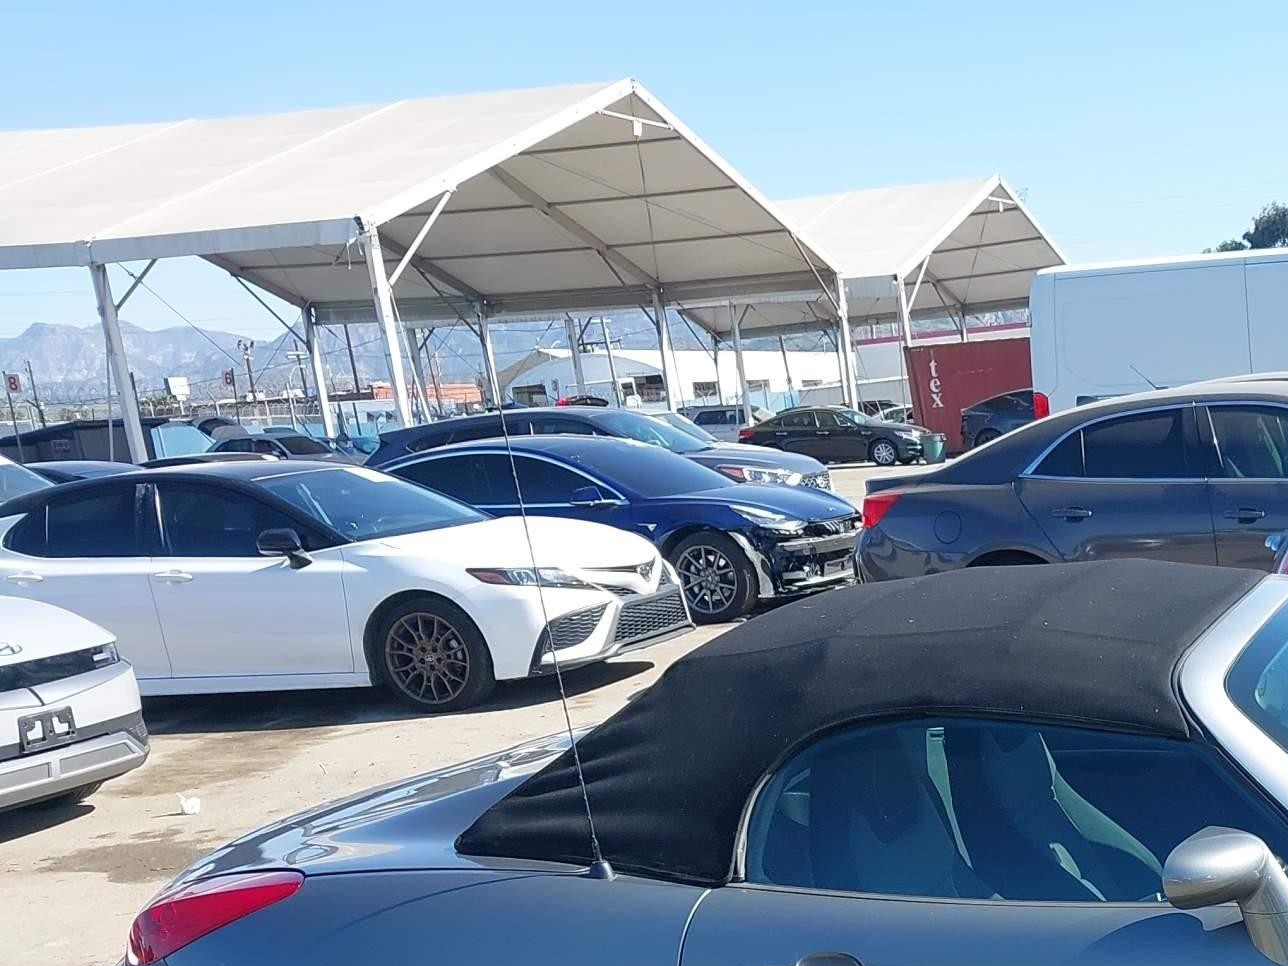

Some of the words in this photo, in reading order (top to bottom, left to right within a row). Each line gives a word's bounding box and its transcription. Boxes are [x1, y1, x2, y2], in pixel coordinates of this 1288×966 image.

[8, 376, 18, 391] 8
[224, 372, 232, 385] 6
[929, 359, 945, 409] tex
